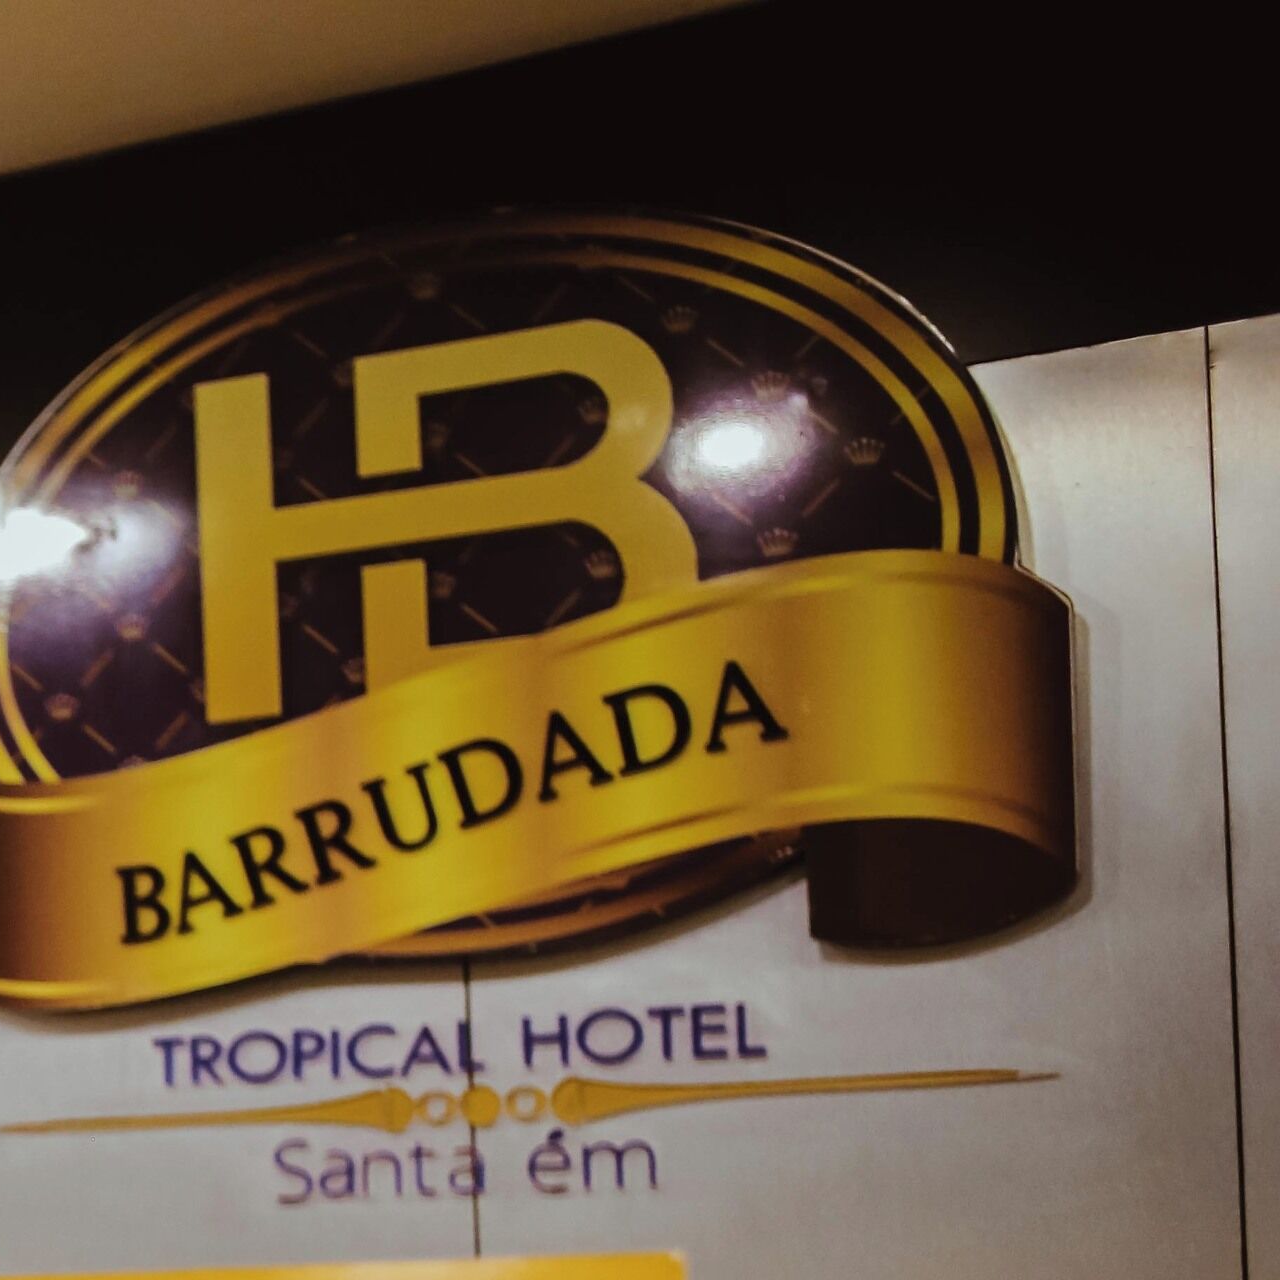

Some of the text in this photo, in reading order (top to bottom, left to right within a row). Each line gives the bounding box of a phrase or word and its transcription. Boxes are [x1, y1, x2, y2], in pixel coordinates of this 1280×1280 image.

[114, 658, 792, 947] BARRUDADA
[152, 1001, 768, 1088] TROPICAL HOTEL
